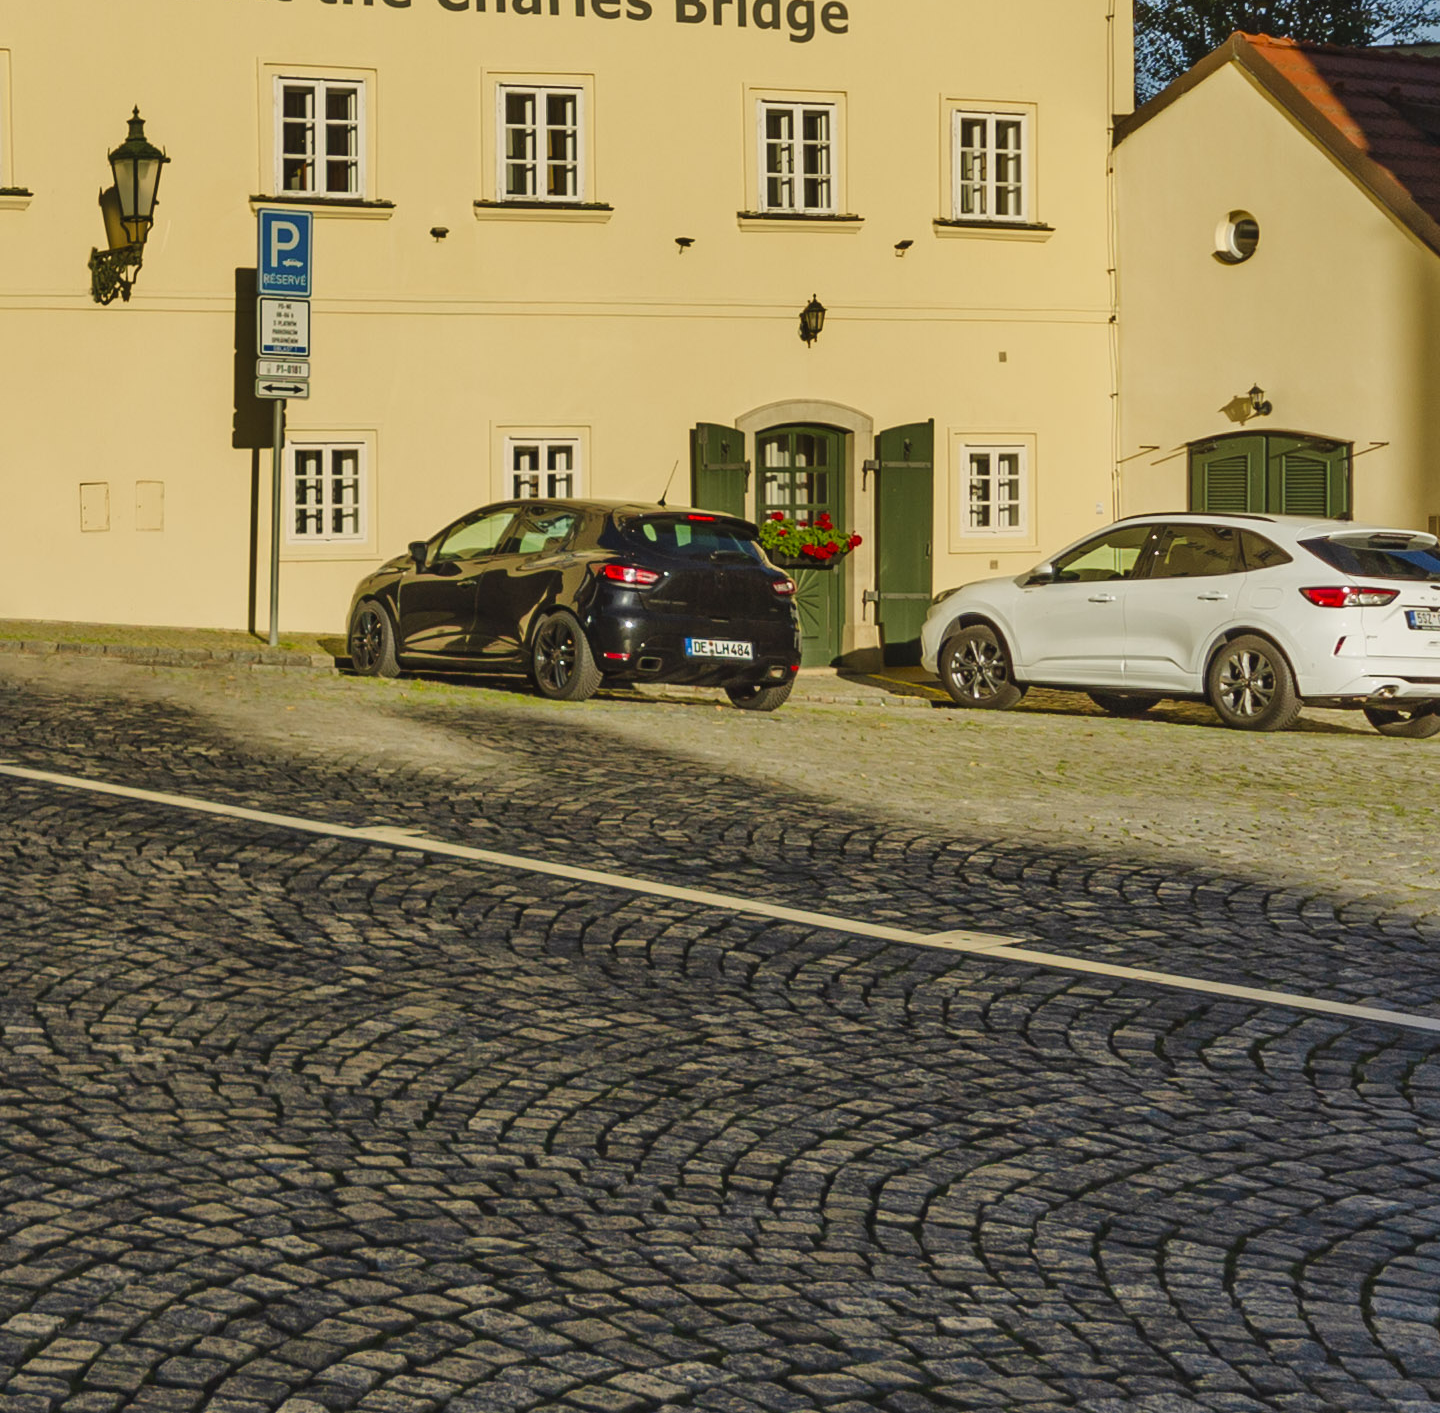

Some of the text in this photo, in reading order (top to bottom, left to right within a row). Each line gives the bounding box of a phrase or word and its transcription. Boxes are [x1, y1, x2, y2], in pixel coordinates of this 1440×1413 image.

[270, 220, 300, 268] P
[263, 272, 307, 287] RÉSERVÉ
[1416, 612, 1433, 625] 5SZ
[693, 640, 708, 654] DE
